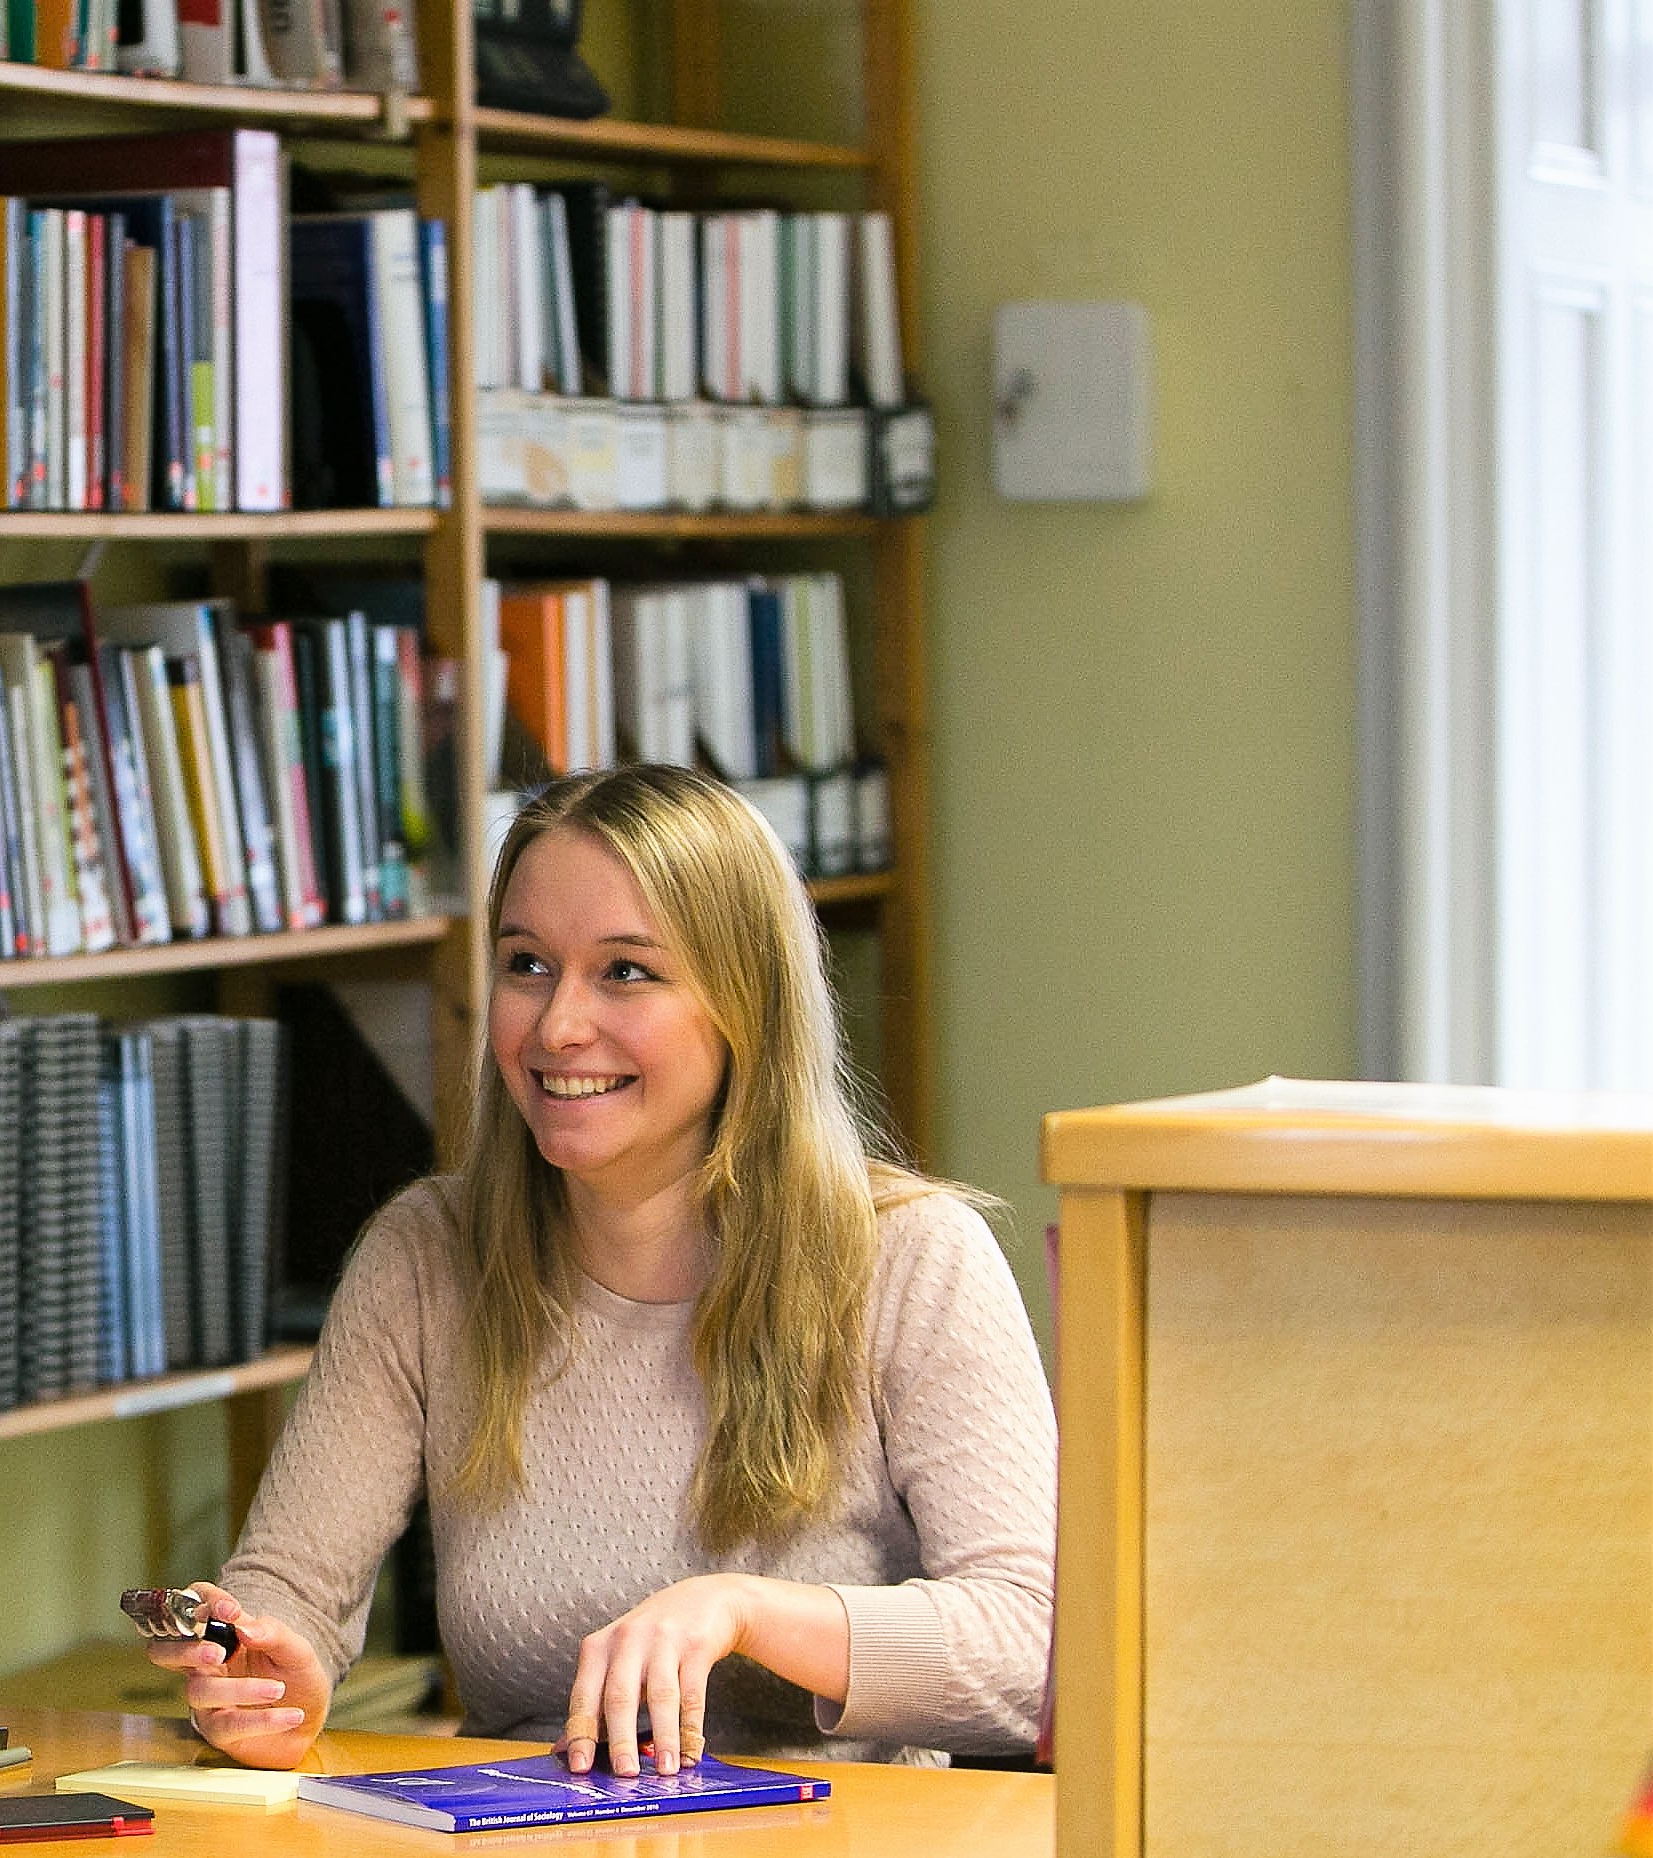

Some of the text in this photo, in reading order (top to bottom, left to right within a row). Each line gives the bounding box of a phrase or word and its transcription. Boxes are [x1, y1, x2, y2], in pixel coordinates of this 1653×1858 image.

[468, 1817, 481, 1828] The
[481, 1816, 503, 1826] British
[503, 1813, 527, 1825] Journal
[534, 1811, 565, 1823] Sociology
[594, 1807, 616, 1816] Number
[620, 1804, 647, 1813] December
